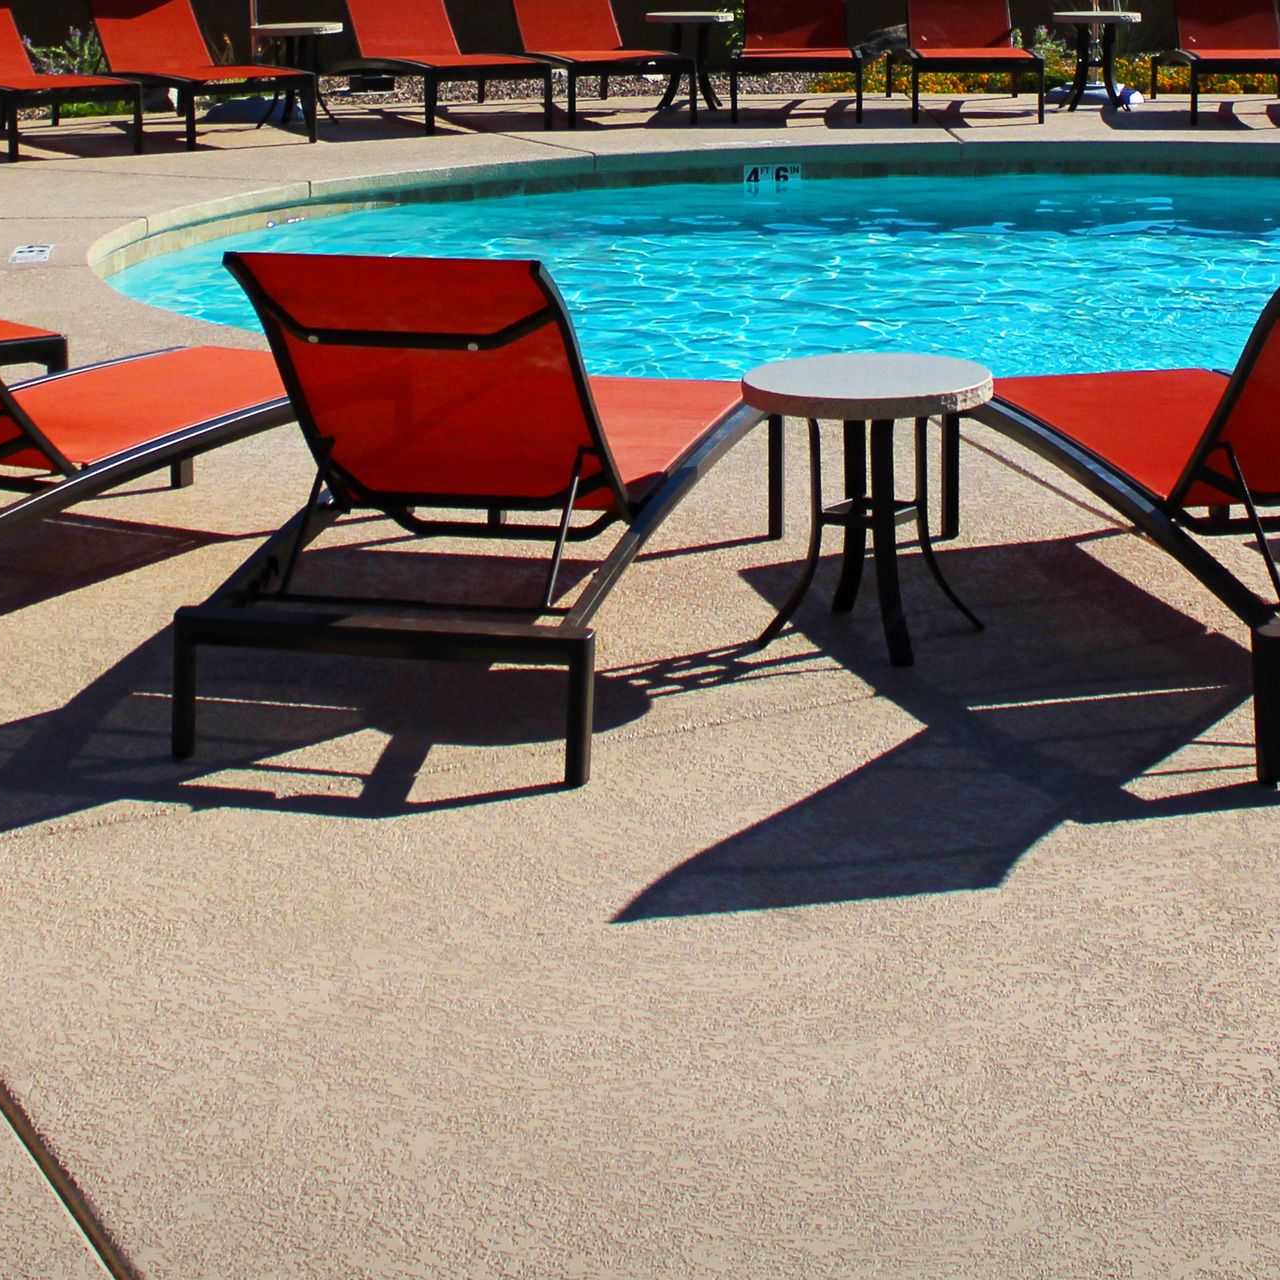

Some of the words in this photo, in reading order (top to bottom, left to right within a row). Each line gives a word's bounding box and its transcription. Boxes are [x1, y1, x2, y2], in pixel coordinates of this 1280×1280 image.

[745, 166, 761, 183] 4
[760, 166, 770, 175] FT
[774, 166, 790, 182] 6
[790, 166, 800, 174] IN
